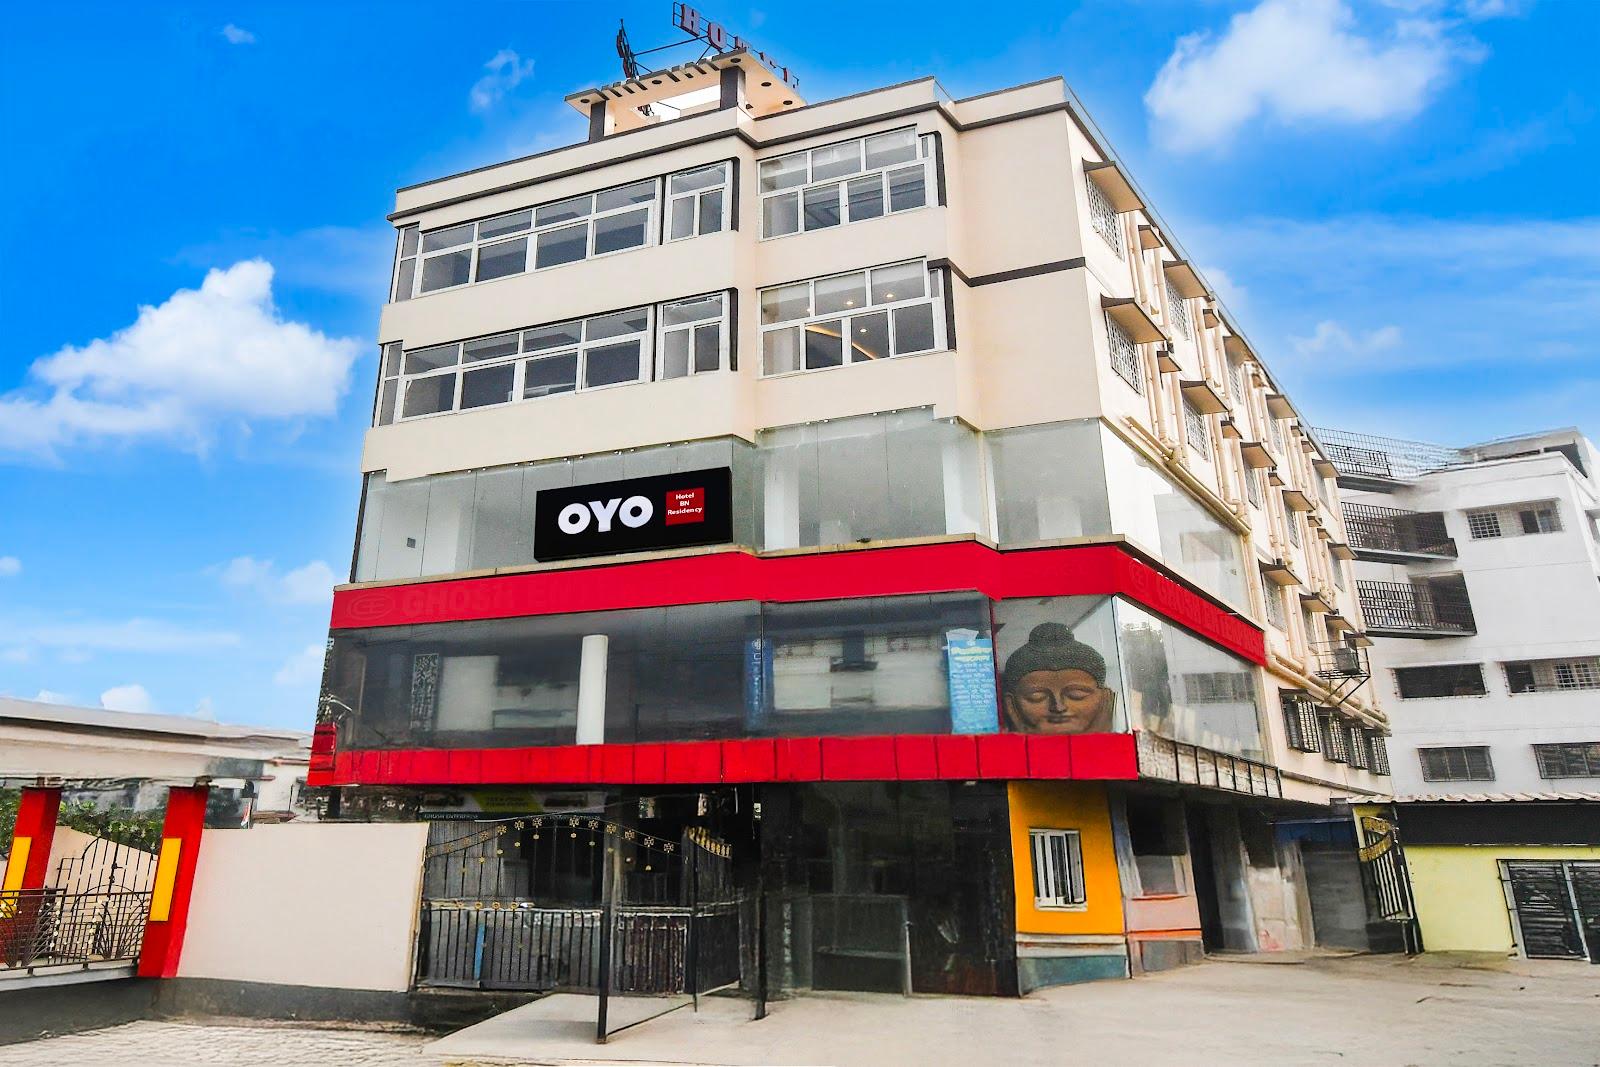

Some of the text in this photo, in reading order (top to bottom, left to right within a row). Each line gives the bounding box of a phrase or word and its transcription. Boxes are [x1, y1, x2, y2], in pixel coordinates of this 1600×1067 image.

[675, 492, 695, 500] Hotel
[679, 499, 690, 507] BN
[557, 495, 654, 535] OYO
[667, 507, 703, 516] Residency
